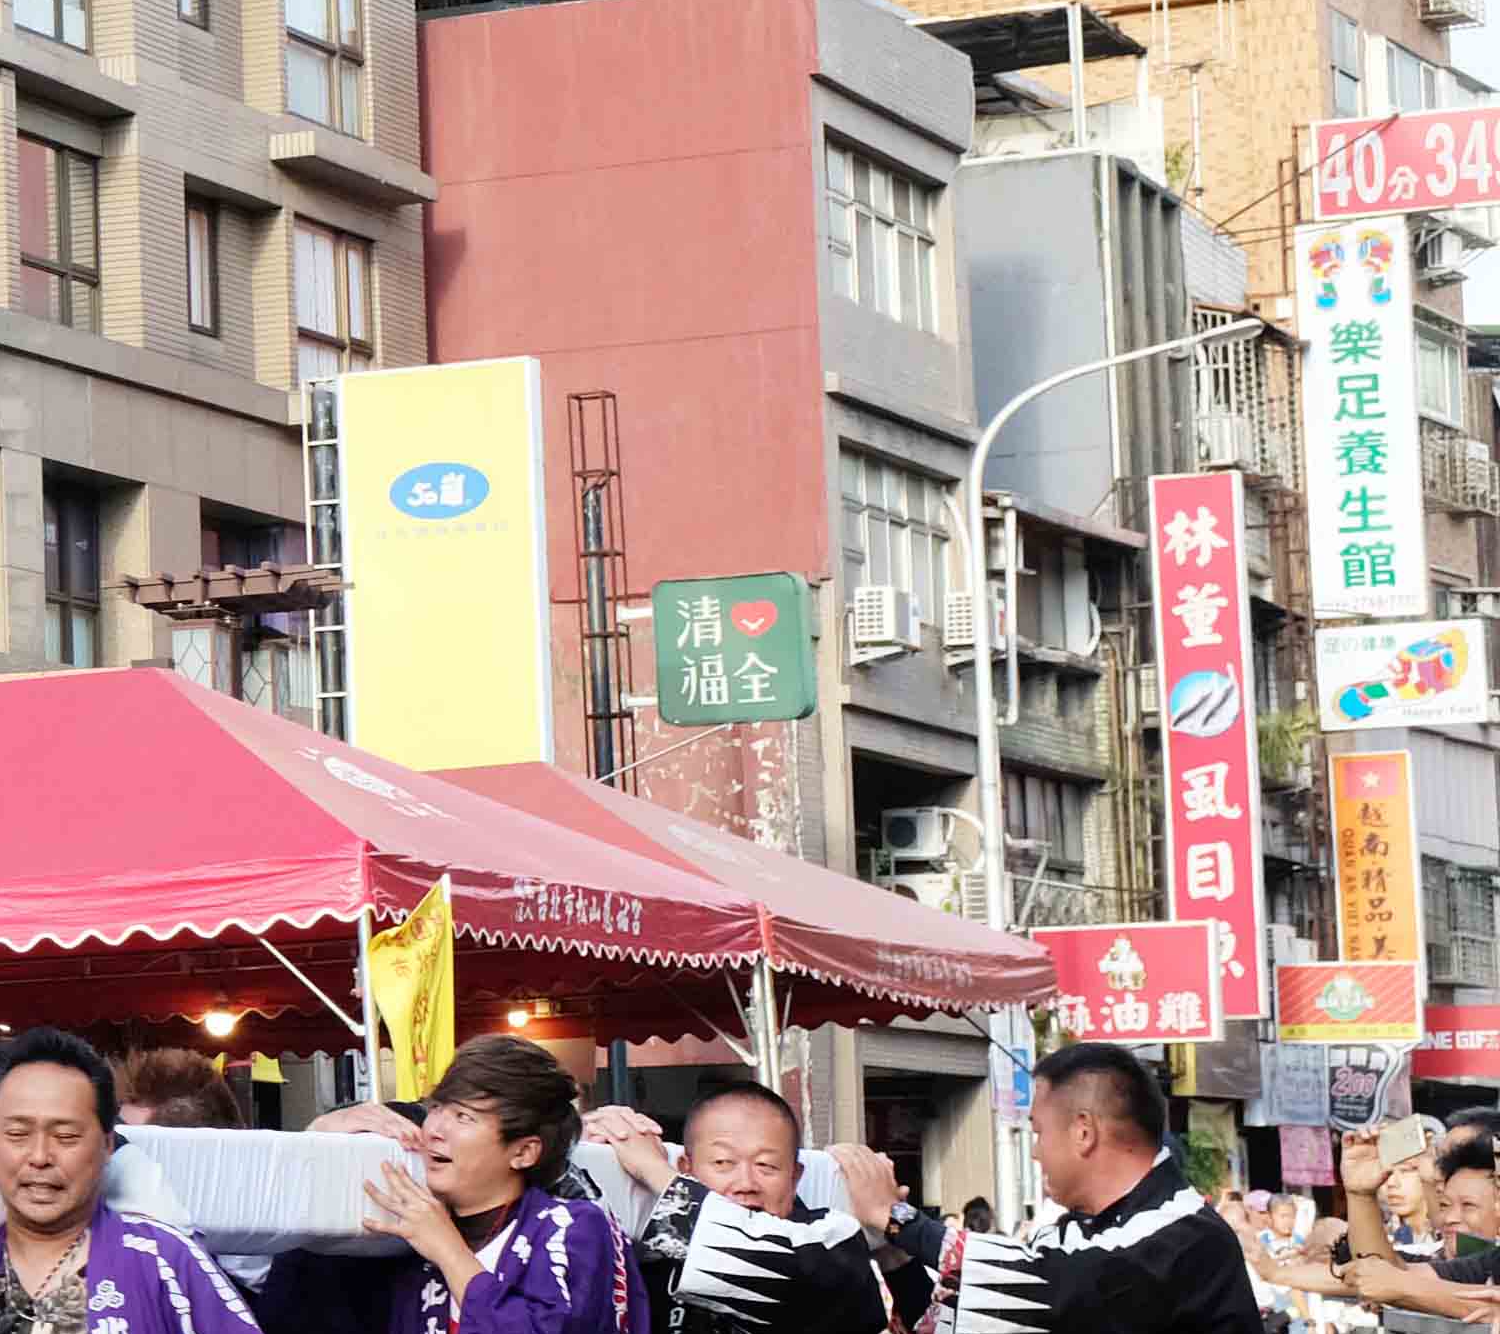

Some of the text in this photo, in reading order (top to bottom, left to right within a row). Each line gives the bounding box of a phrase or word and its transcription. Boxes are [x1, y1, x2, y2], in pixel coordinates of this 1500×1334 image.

[1329, 318, 1397, 589] 樂足養生館
[676, 598, 723, 650] 清
[1163, 506, 1230, 648] 林董
[680, 657, 779, 706] 福全
